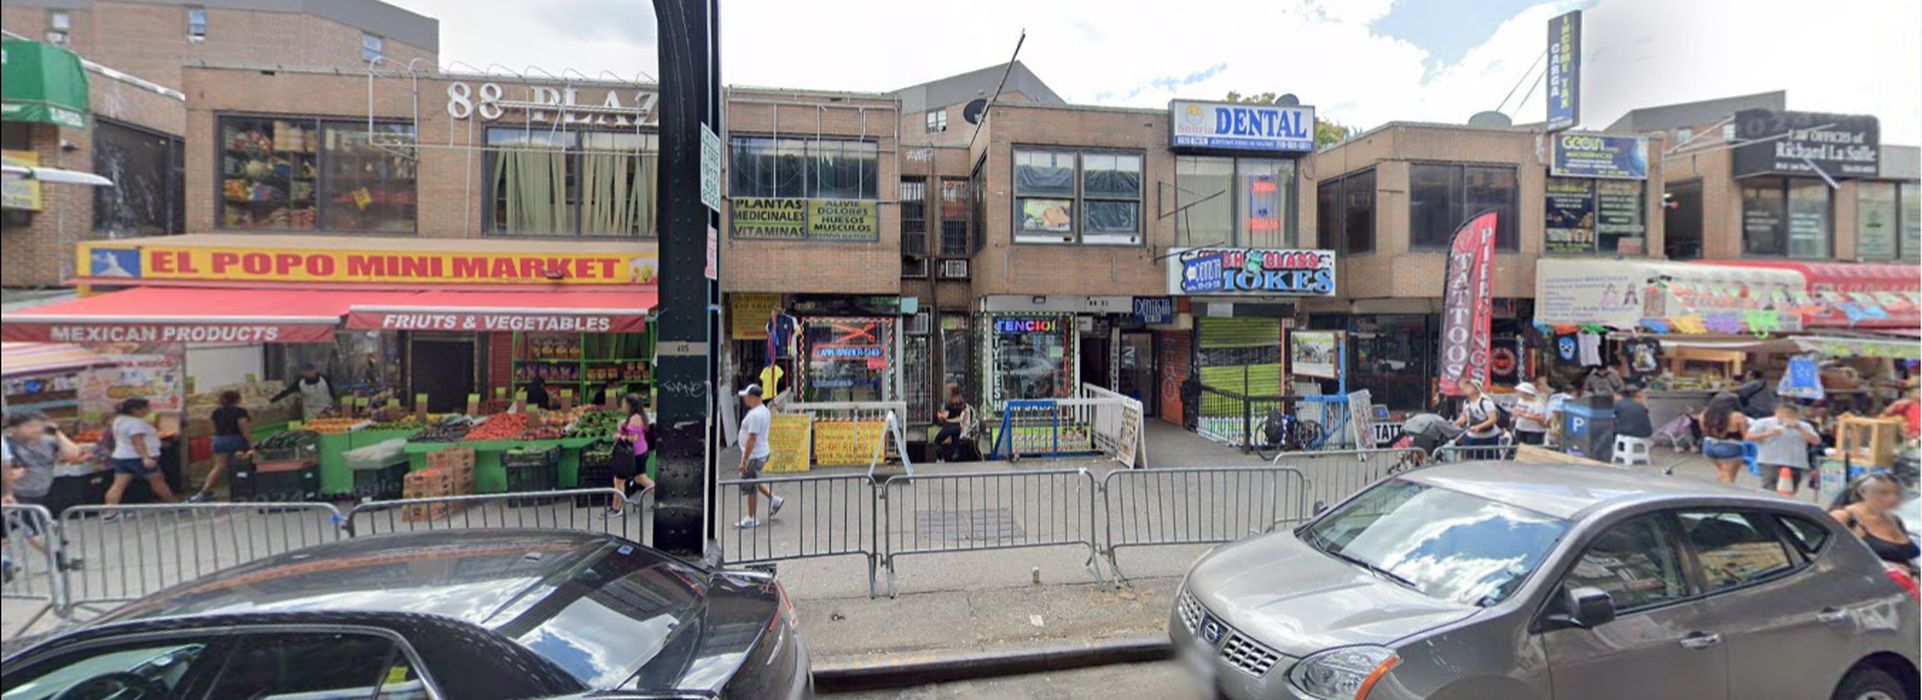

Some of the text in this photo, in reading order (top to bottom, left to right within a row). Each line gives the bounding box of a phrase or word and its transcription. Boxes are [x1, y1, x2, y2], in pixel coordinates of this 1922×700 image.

[1560, 14, 1571, 73] INCOME
[1550, 43, 1560, 97] CARGA
[447, 82, 658, 125] 88 PLAZ
[1560, 77, 1569, 109] TAX
[1215, 107, 1307, 138] DENTAL
[1775, 141, 1826, 159] Richard
[1829, 145, 1843, 160] La
[735, 199, 803, 209] PLANTAS
[818, 207, 868, 215] DOLORES
[734, 211, 804, 221] MEDICINALES
[822, 216, 864, 224] HUESOS
[813, 224, 871, 232] MUSCULOS
[151, 251, 621, 279] EL POPO MINI MARKET
[1224, 268, 1334, 292] OKES
[1470, 227, 1493, 384] PIERCINGS
[383, 314, 611, 331] FRIUTS & VEGETABLES
[1446, 251, 1471, 383] TATTOOS
[51, 326, 279, 342] MEXICAN PRODUCTS
[1374, 423, 1403, 440] TATT
